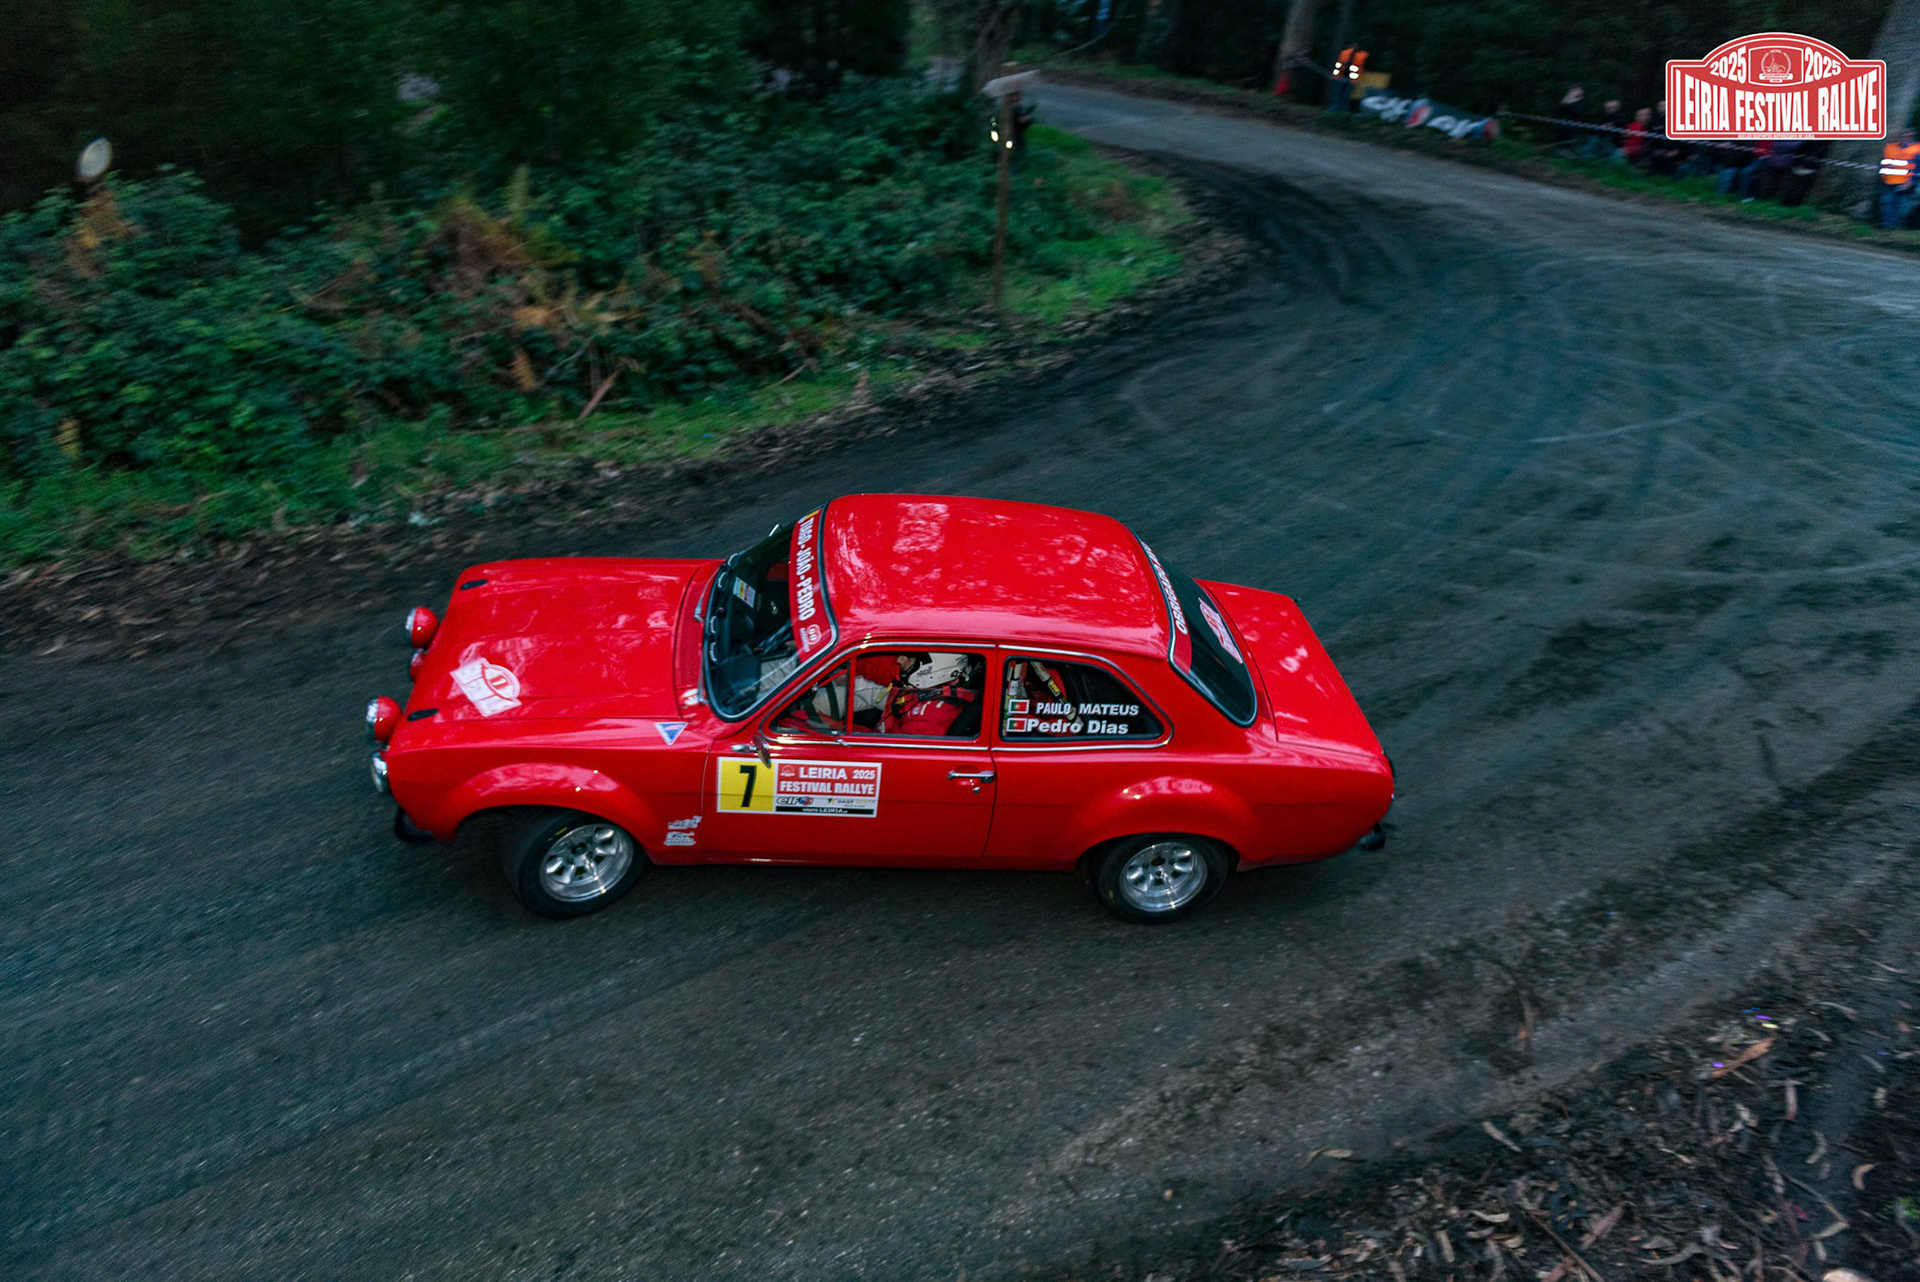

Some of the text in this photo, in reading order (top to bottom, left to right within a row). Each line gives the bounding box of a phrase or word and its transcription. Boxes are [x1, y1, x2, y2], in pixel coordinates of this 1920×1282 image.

[1035, 702, 1139, 716] PAULO MATEUS
[1026, 718, 1129, 734] Pedro Dias
[799, 767, 875, 780] LEIRIA 2025
[739, 765, 757, 808] 7
[780, 781, 875, 795] FESTIVAL RALLYE
